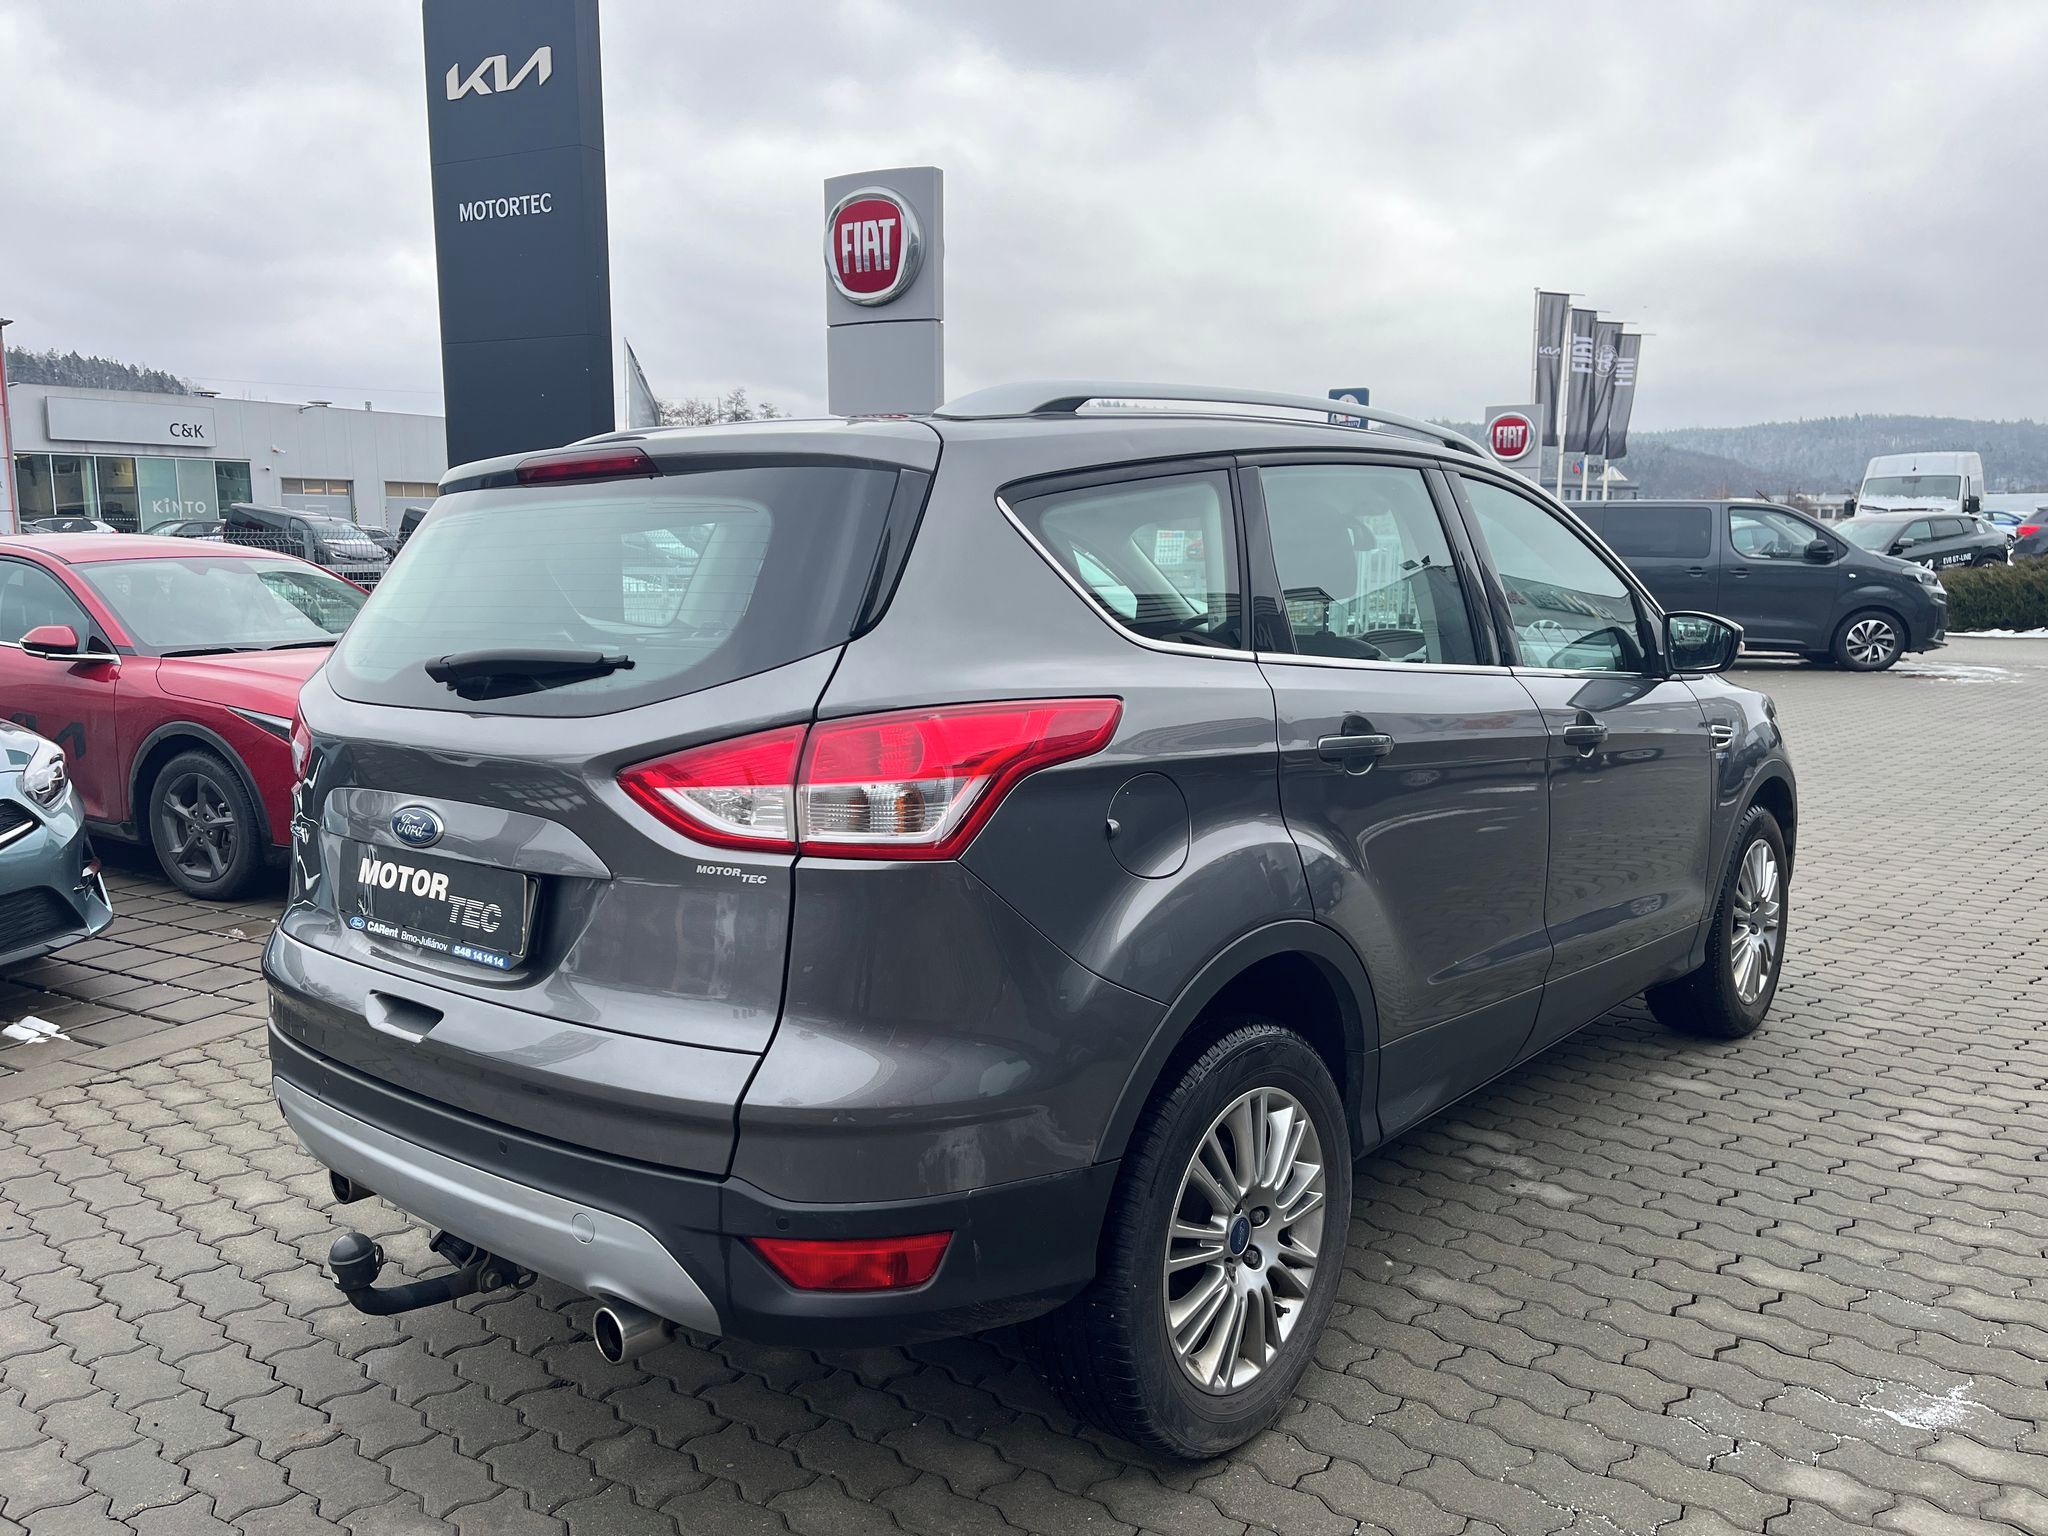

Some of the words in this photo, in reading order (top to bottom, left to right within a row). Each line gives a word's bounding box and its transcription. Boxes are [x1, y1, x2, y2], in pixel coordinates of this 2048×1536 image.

[445, 45, 552, 100] KIA
[459, 192, 552, 222] MOTORTEC
[841, 218, 896, 275] FIAT
[1572, 333, 1592, 373] FIAT
[169, 422, 205, 439] C&K
[1496, 424, 1525, 449] FIAT
[396, 812, 426, 838] Ford
[358, 858, 449, 901] MOTOR
[696, 865, 741, 877] MOTOR
[741, 874, 767, 884] TEC
[448, 895, 502, 933] TEC
[367, 921, 398, 938] CARent
[401, 931, 448, 951] Brno-Juliánov
[454, 947, 472, 958] 548
[473, 951, 483, 962] 14
[483, 954, 493, 964] 14
[493, 957, 505, 968] 14
